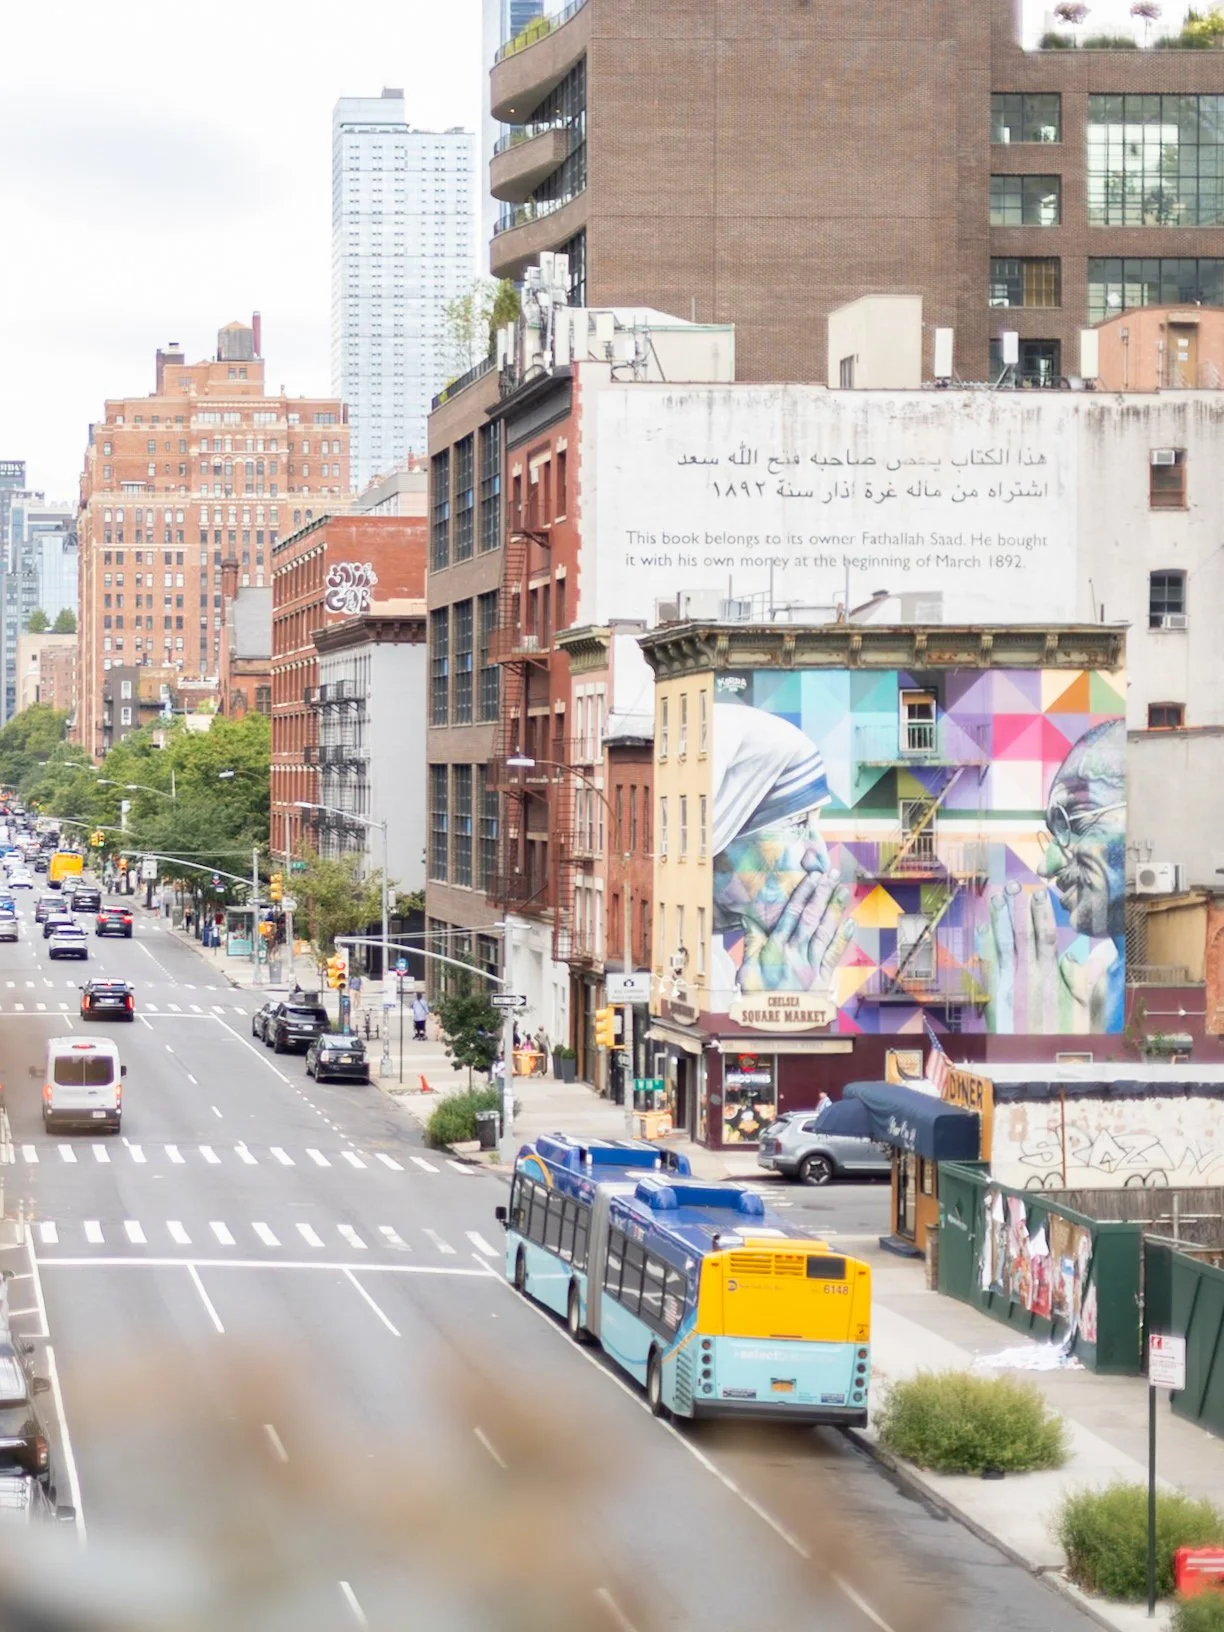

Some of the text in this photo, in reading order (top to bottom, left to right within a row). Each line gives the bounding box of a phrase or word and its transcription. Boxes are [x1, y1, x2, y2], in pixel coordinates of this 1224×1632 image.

[676, 452, 720, 467] سعد
[767, 449, 801, 475] فتح
[810, 448, 877, 472] صاحبه
[950, 448, 1010, 473] الكتاب
[1018, 447, 1048, 467] هذا
[712, 480, 766, 498] ١٨٩٢
[775, 479, 814, 499] سنة
[864, 480, 898, 504] غرة
[950, 483, 979, 504] من
[987, 479, 1048, 504] اشتراه
[625, 530, 1048, 550] This book belongs to its owner Fathallah Saad. He bought
[625, 553, 1026, 571] it with his own money at the beginning of March 1892.
[767, 996, 801, 1007] CHELSEA
[742, 1010, 827, 1024] SQUARE MARKET
[949, 1072, 984, 1110] DINER
[823, 1285, 849, 1295] 6148
